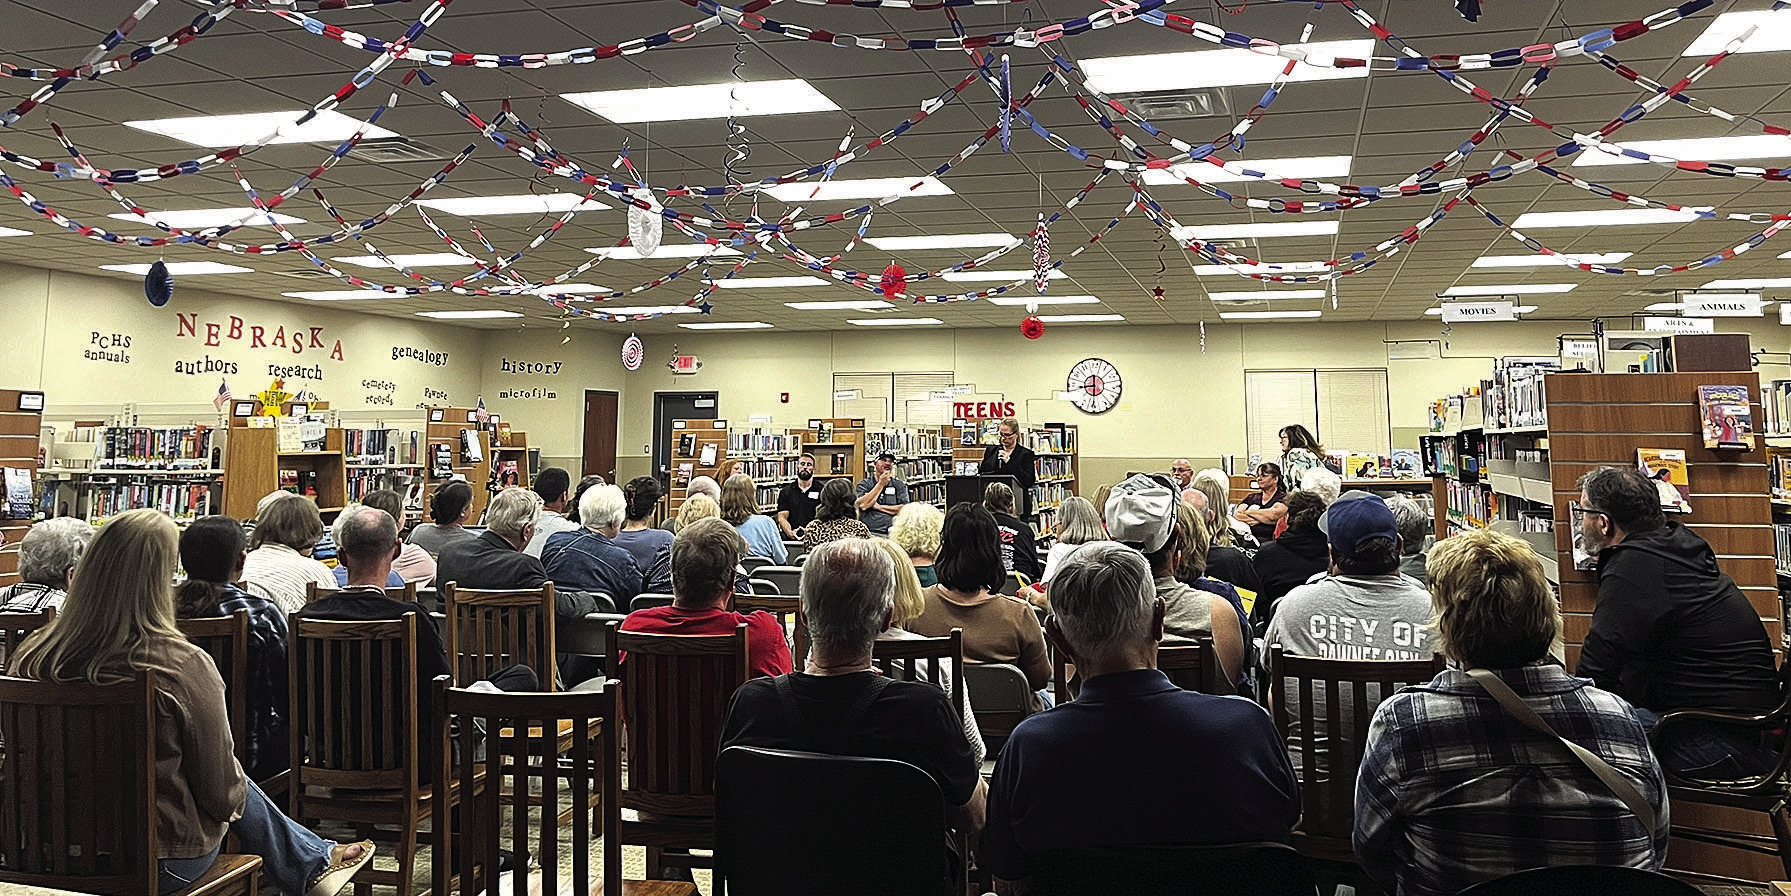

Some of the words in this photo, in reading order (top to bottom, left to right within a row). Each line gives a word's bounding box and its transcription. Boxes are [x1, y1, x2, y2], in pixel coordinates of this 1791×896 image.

[1459, 307, 1497, 316] MOVIES
[1699, 303, 1746, 311] ANIMALS
[91, 331, 132, 349] PCHS
[176, 312, 345, 361] NEBRASKA
[84, 349, 131, 364] annuals
[391, 345, 449, 367] genealogy
[678, 356, 693, 368] EXIT
[175, 355, 238, 375] authors
[268, 363, 323, 381] research
[500, 357, 563, 375] history
[362, 379, 396, 393] cemetery
[424, 387, 448, 401] Pawnee
[499, 387, 557, 399] microfilm
[365, 393, 393, 406] records
[953, 401, 1016, 418] TEENS
[1309, 614, 1379, 644] CITY
[1393, 621, 1428, 648] OF
